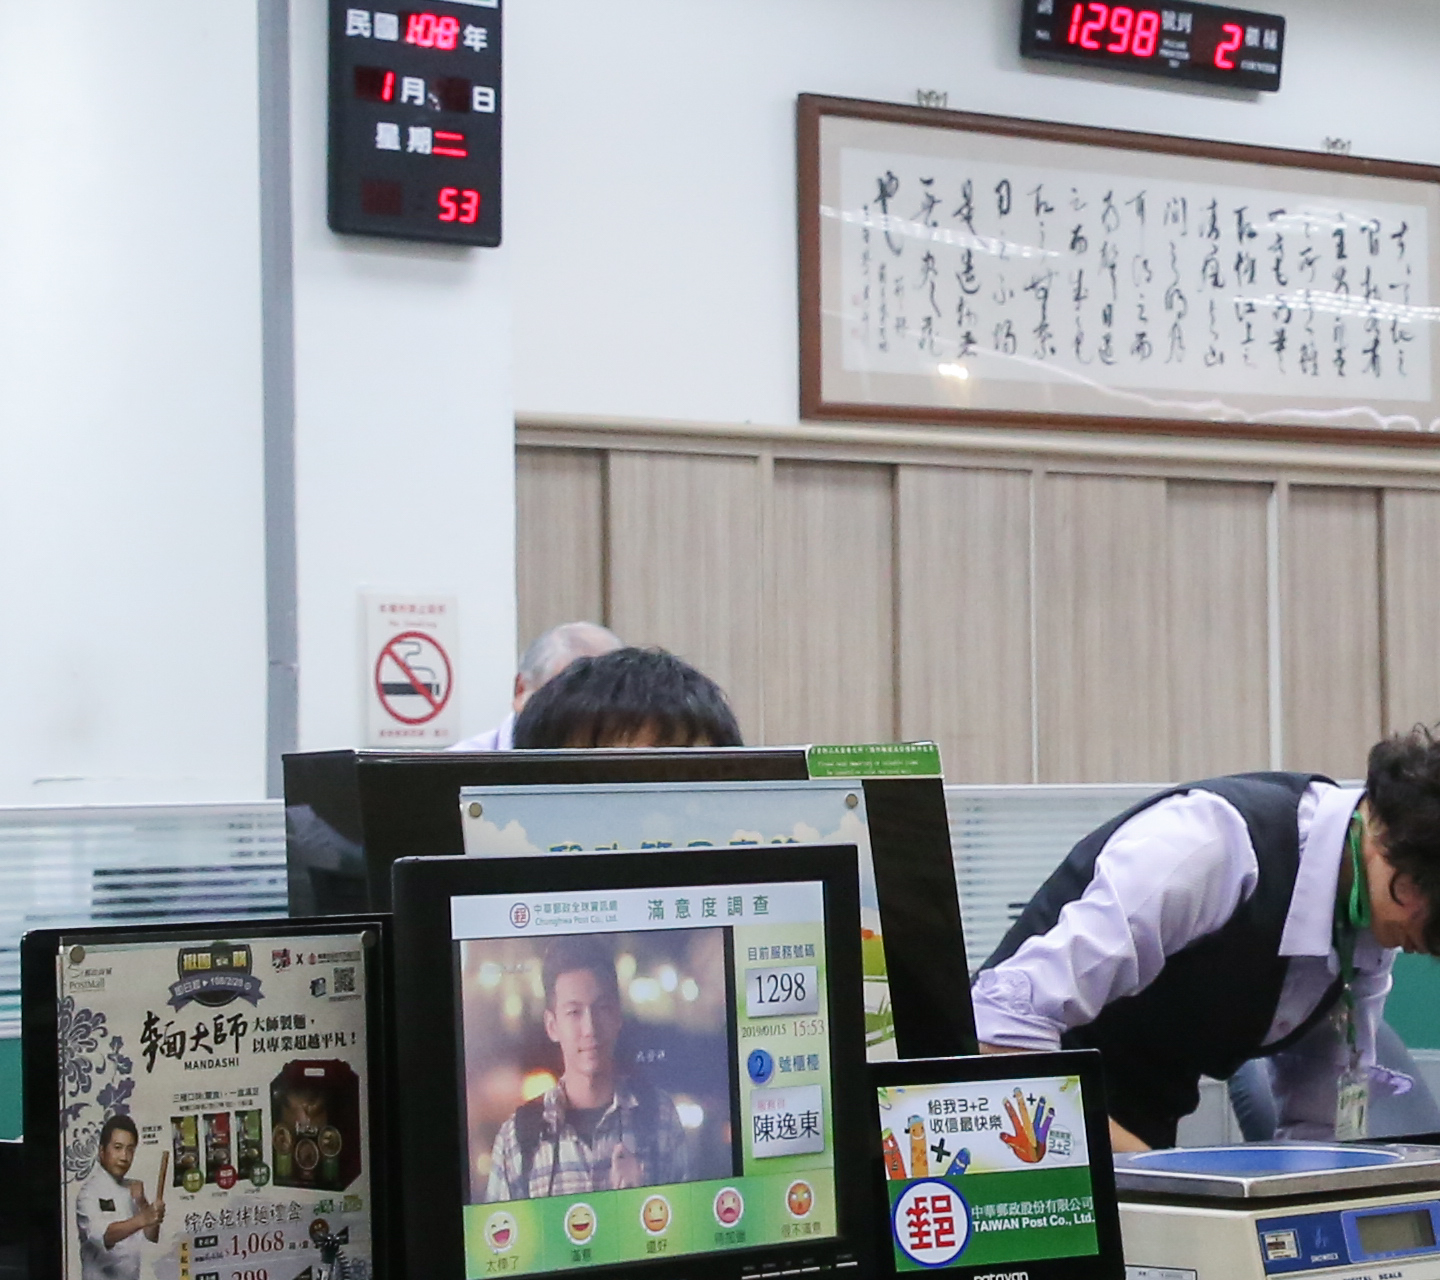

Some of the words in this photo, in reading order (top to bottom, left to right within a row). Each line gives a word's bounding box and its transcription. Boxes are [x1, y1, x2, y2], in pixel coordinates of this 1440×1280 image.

[405, 12, 459, 51] 108
[463, 24, 489, 52] 年
[1067, 1, 1160, 58] 1298
[1214, 23, 1243, 70] 2
[381, 70, 396, 102] 1
[401, 76, 425, 106] 月
[472, 85, 496, 114] 日
[438, 186, 481, 224] 53
[647, 894, 770, 921] 滿意度調查
[747, 943, 816, 961] 目前服務號碼
[754, 972, 807, 1004] 1298
[792, 1019, 825, 1037] 15:53
[183, 1057, 240, 1071] MANDASHI
[754, 1054, 766, 1078] 2
[927, 1096, 989, 1116] 給我3+2
[752, 1109, 821, 1144] 陳逸東
[929, 1114, 1004, 1135] 收信最快樂
[971, 1195, 1094, 1219] 中華郵政股份有限公司
[972, 1218, 1020, 1233] TAIWAN
[1022, 1216, 1048, 1229] Post
[1049, 1213, 1072, 1227] Co.,
[1074, 1212, 1096, 1224] Ltd.
[485, 1254, 520, 1272] 太棒了
[1378, 1271, 1404, 1280] SCALE
